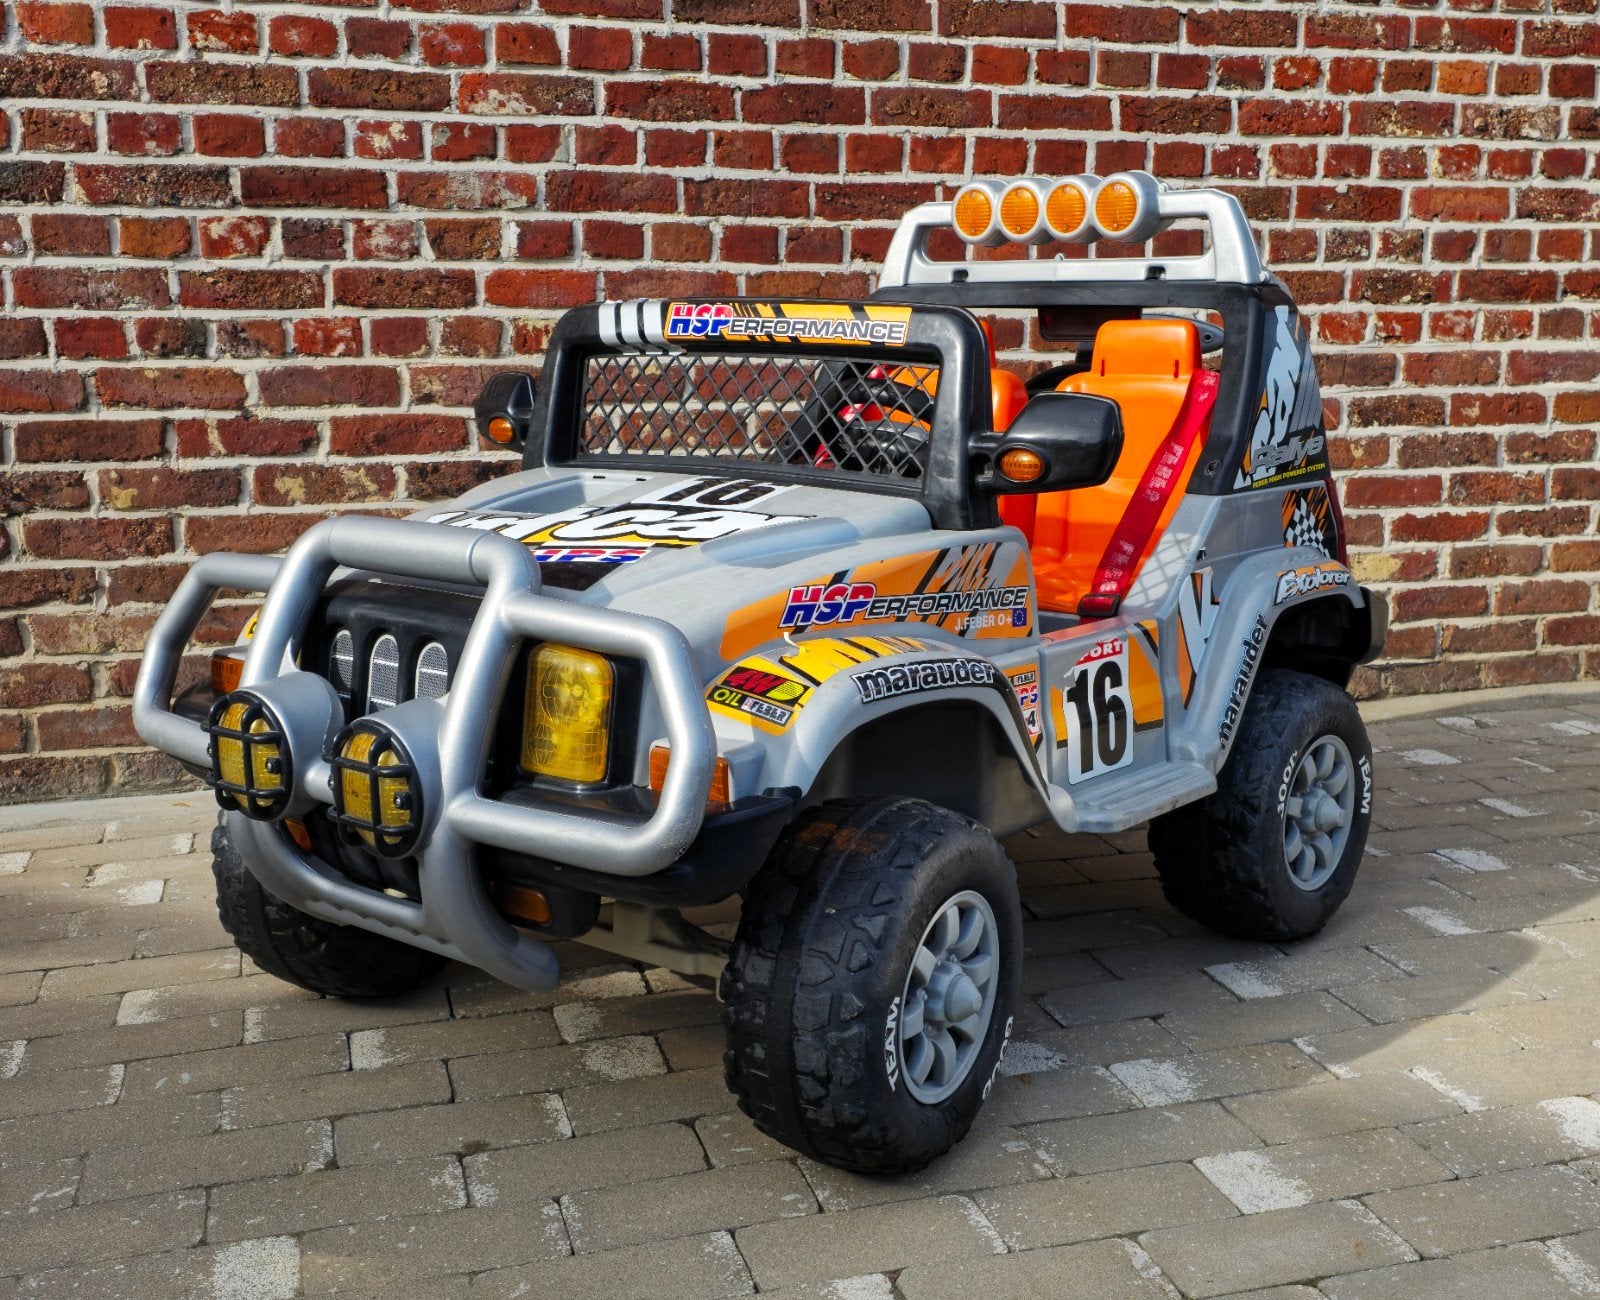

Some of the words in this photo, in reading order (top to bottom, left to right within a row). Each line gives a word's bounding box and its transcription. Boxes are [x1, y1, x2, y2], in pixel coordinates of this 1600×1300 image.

[1275, 566, 1350, 605] Explorer
[713, 688, 742, 706] OIL
[853, 659, 995, 702] marauder
[1219, 612, 1268, 752] marauder
[1067, 661, 1127, 774] 16
[884, 996, 900, 1093] TEAM
